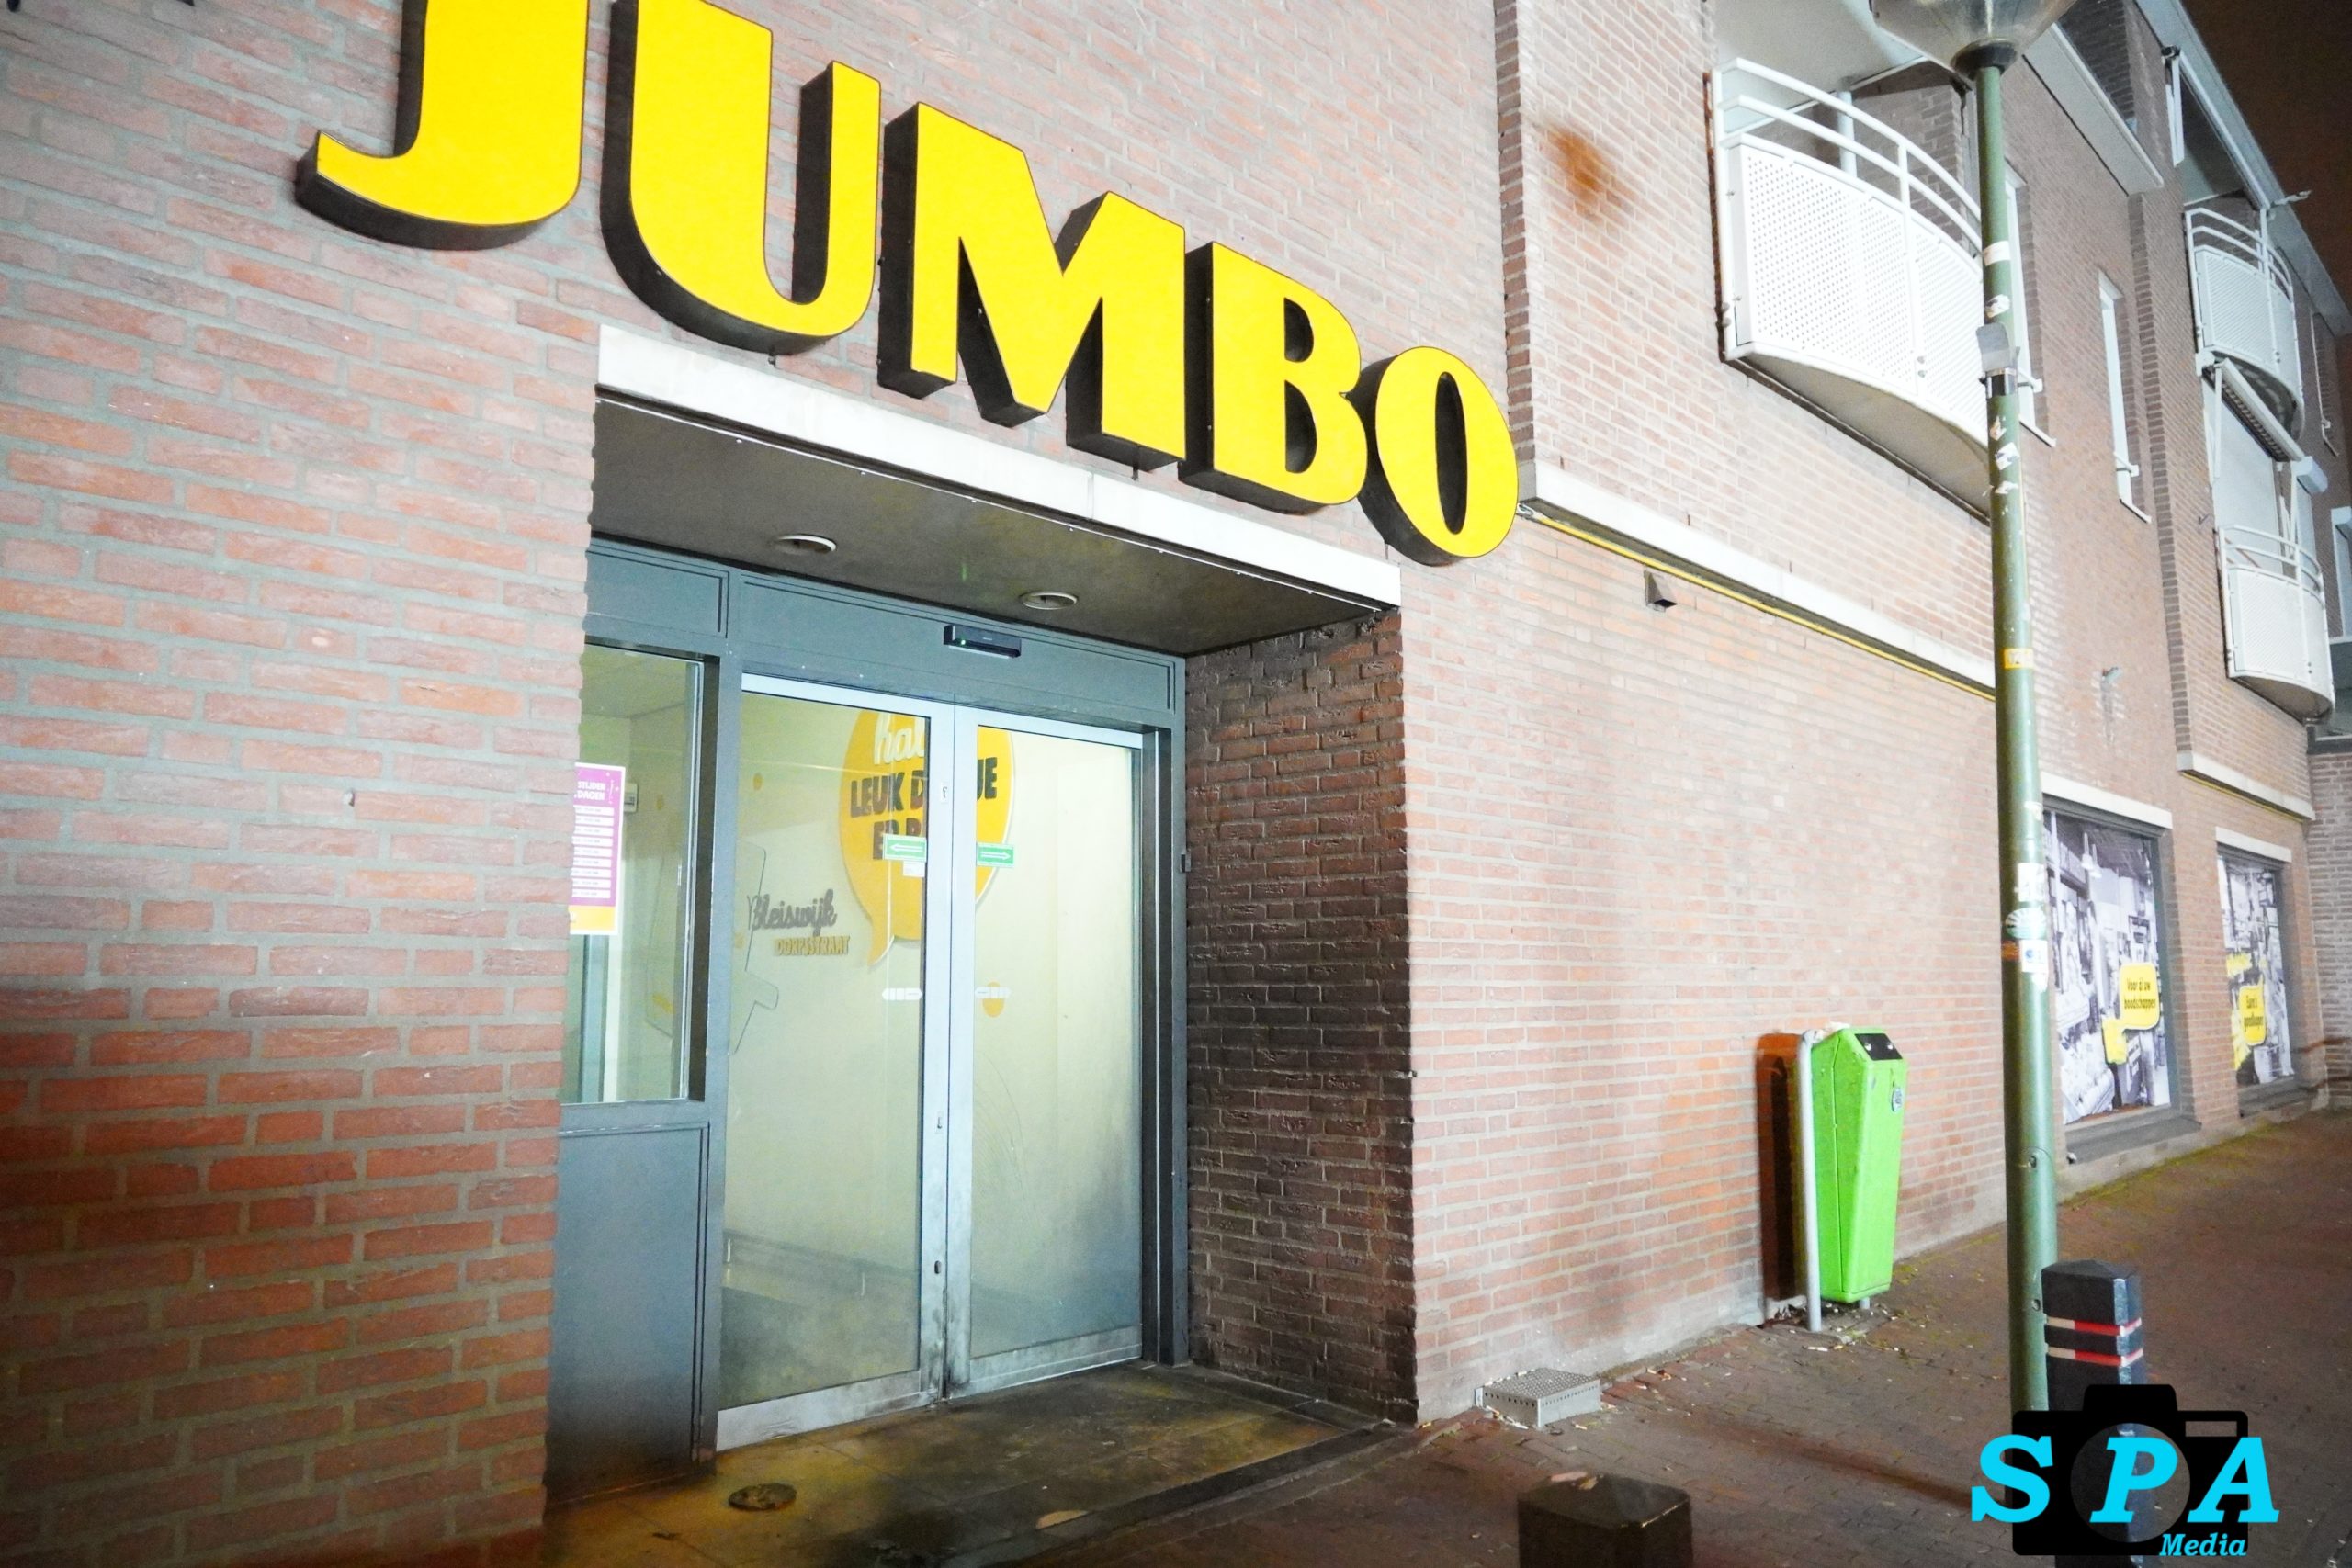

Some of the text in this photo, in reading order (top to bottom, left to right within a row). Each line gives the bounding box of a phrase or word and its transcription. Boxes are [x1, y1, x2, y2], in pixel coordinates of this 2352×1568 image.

[298, 0, 1521, 566] JUMBO
[573, 789, 605, 801] DAGEN
[851, 772, 905, 818] LEUK
[748, 888, 838, 937] Bleiswijk
[775, 935, 851, 956] DORPSSTRAAT
[2123, 995, 2156, 1011] boodschappen
